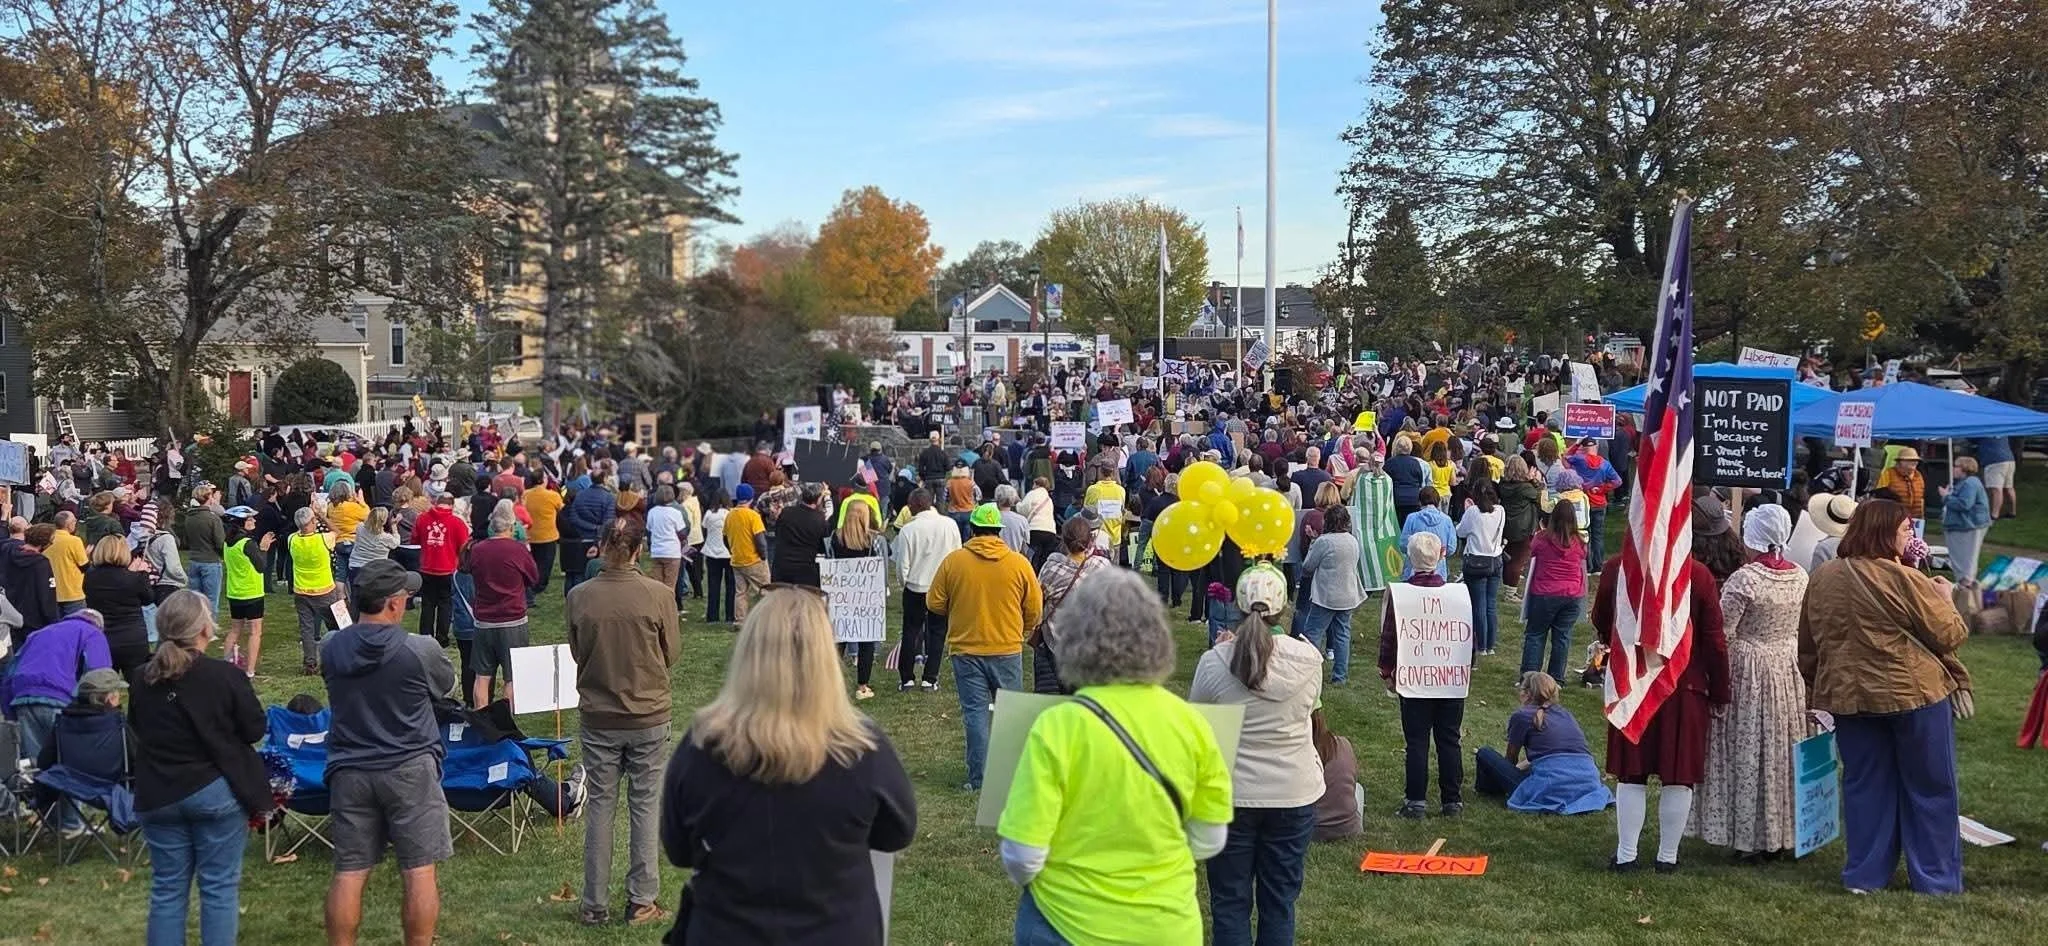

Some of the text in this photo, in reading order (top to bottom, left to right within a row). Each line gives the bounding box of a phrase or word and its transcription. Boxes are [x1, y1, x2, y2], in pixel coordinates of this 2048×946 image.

[1744, 348, 1779, 367] Liberty
[1704, 389, 1784, 411] NOT PAID
[1702, 413, 1769, 431] I'm here
[1714, 430, 1763, 443] because
[1702, 444, 1713, 456] I
[1752, 446, 1768, 457] to
[1716, 467, 1745, 476] must
[1746, 467, 1761, 478] be
[829, 560, 882, 574] IT'S NOT
[832, 575, 877, 589] ABOUT
[853, 605, 884, 617] ABOUT
[1423, 597, 1442, 614] I'M
[1400, 618, 1471, 642] ASHAMED
[1414, 642, 1451, 660] of my
[1372, 858, 1475, 872] NOPE
